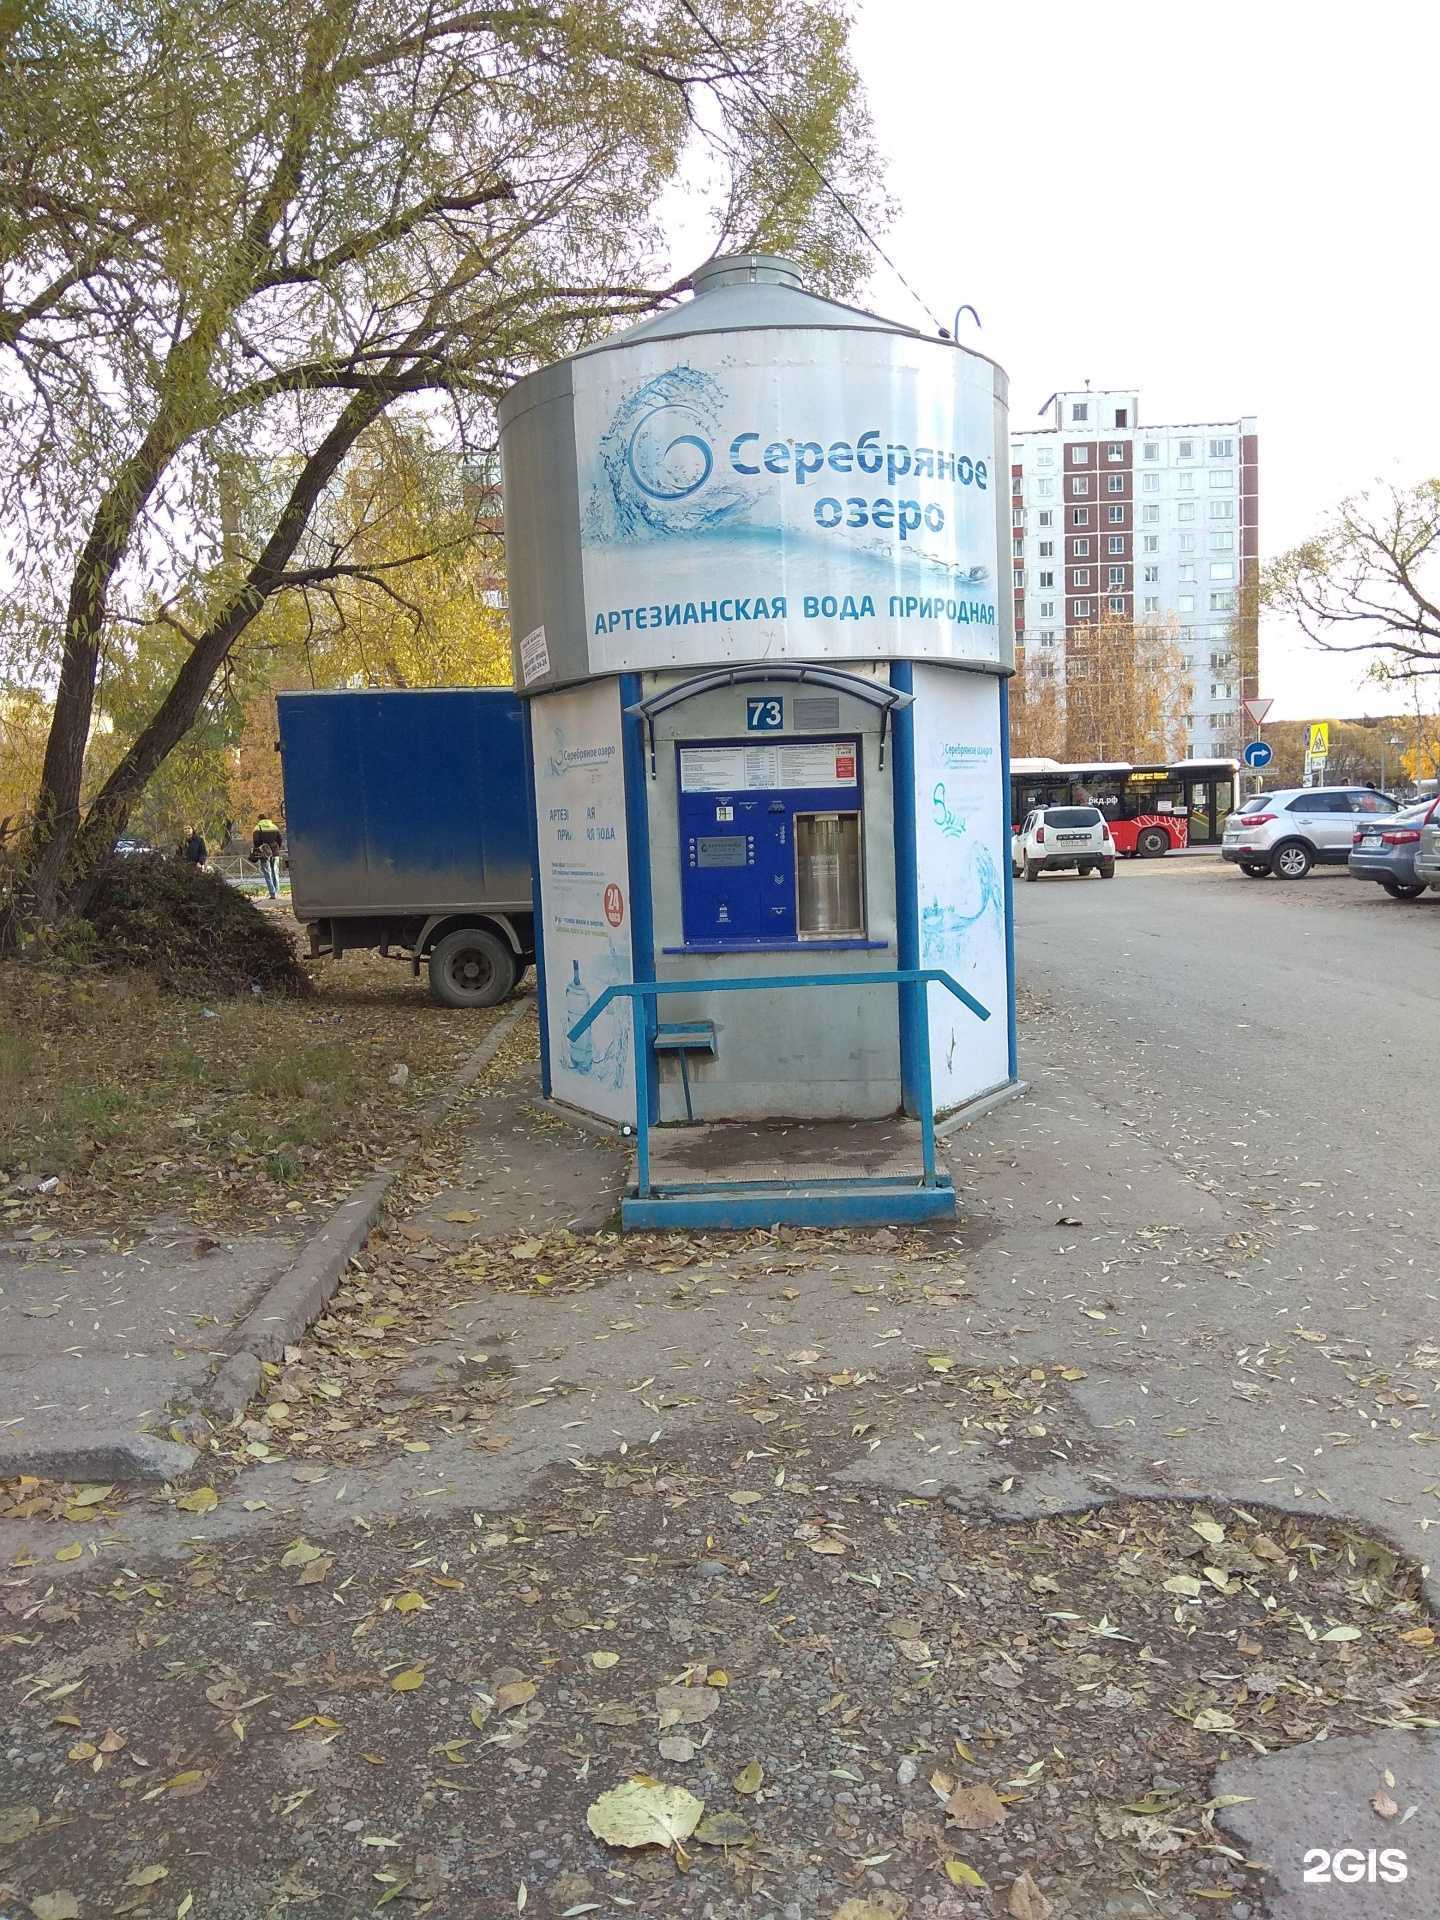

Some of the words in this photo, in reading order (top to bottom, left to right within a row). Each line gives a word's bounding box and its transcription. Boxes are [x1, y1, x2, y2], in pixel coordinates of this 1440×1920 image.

[729, 430, 988, 490] Серебряное
[813, 497, 946, 540] озеро
[594, 596, 788, 635] АРТЕЗИАНСКАЯ
[803, 595, 876, 620] ВОДА
[889, 596, 996, 627] ПРИРОДНАЯ
[749, 701, 782, 726] 73
[1088, 795, 1119, 806] бкд.рф
